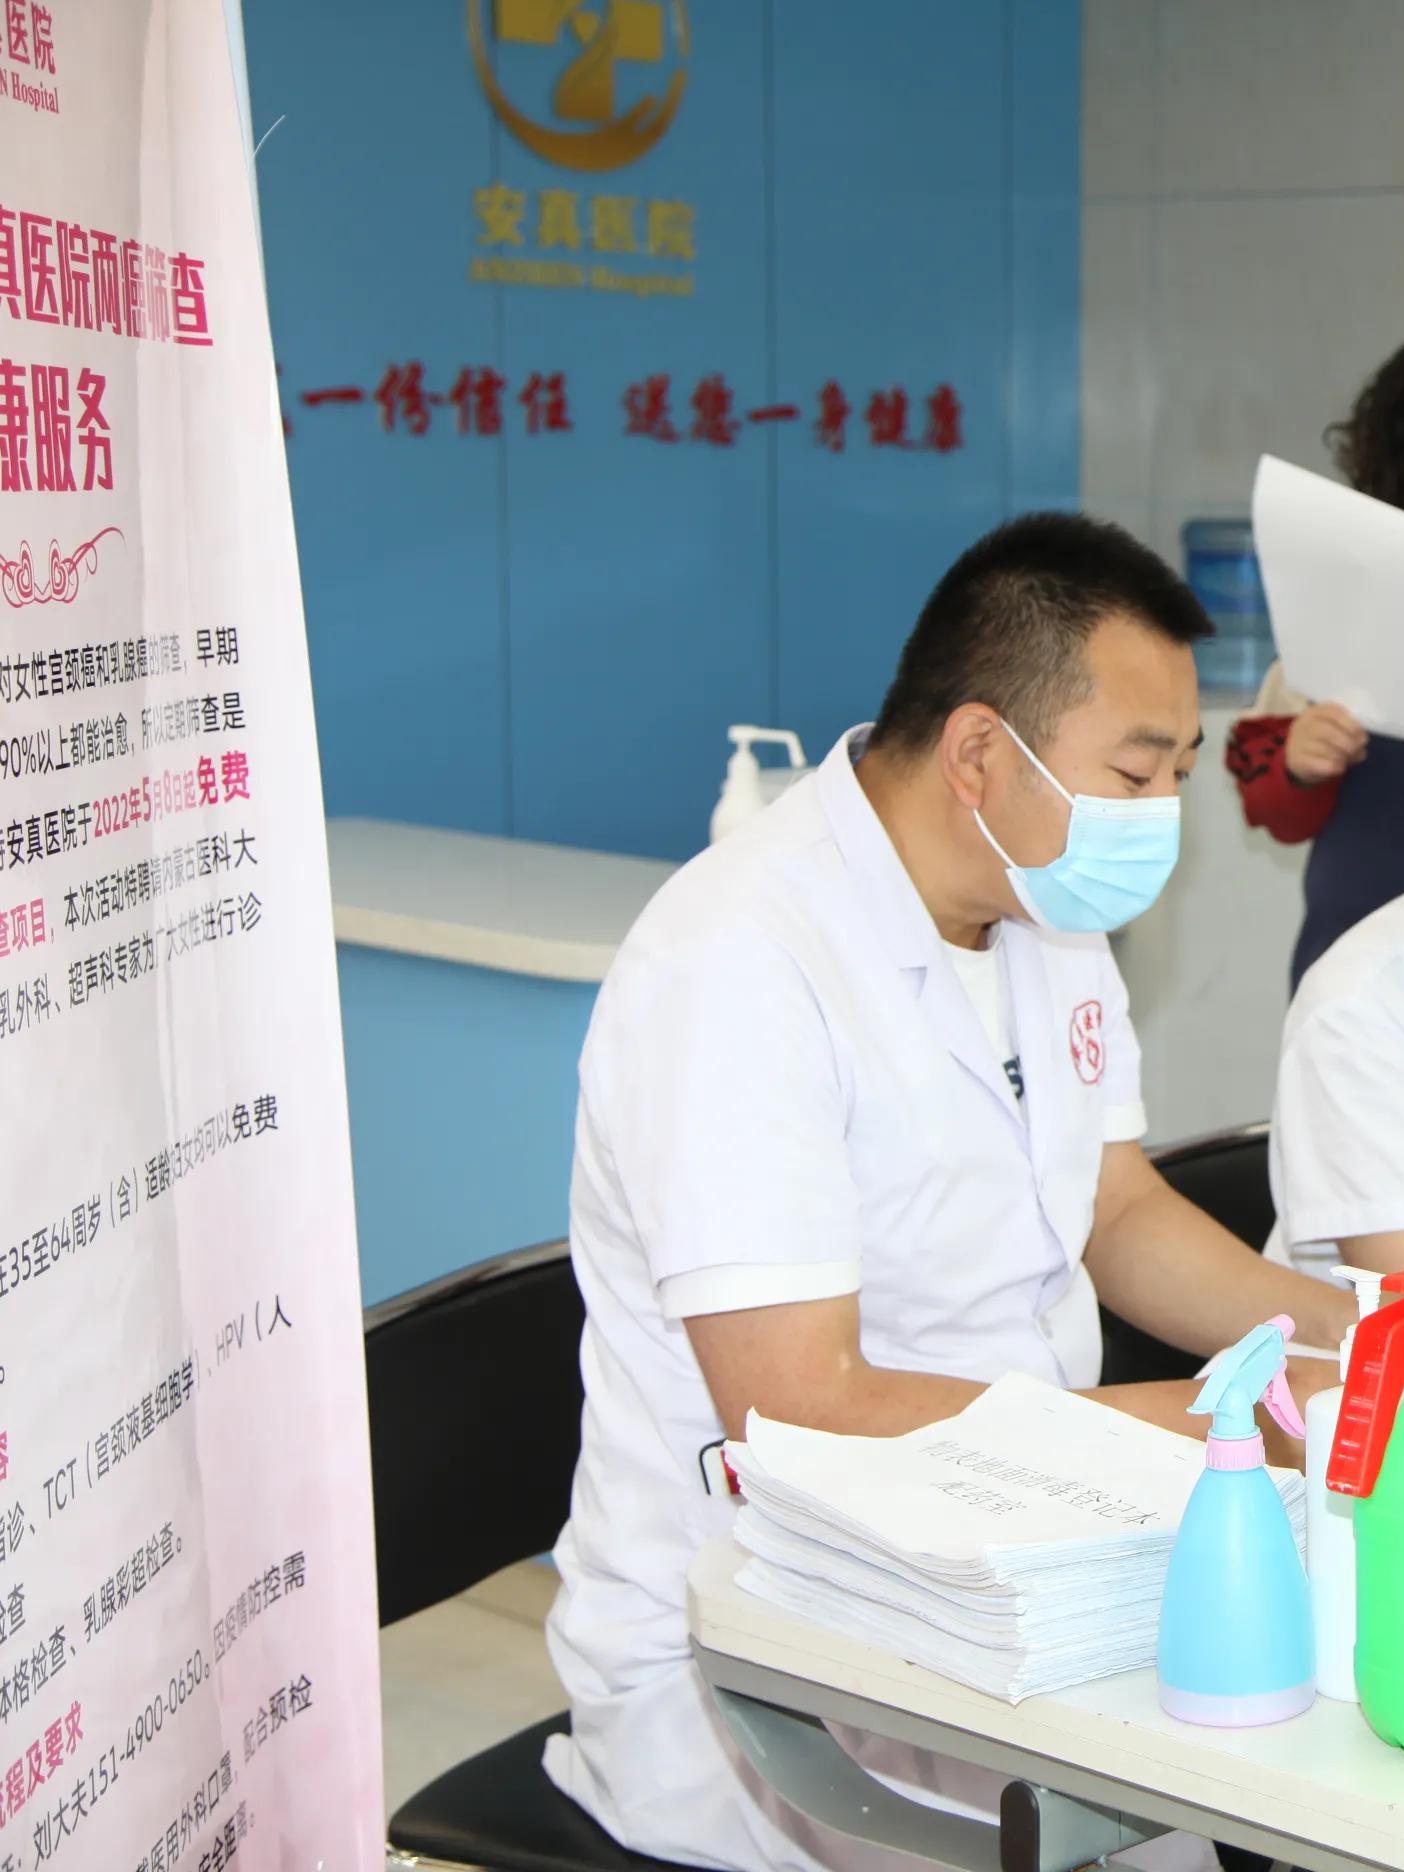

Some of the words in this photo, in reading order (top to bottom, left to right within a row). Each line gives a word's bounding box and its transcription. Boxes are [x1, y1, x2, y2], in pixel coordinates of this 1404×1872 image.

[0, 0, 56, 75] 医院
[11, 71, 59, 114] Hospital
[474, 181, 697, 259] 安真医院
[277, 361, 574, 437] 一份信任
[0, 1700, 83, 1829] 程及要求
